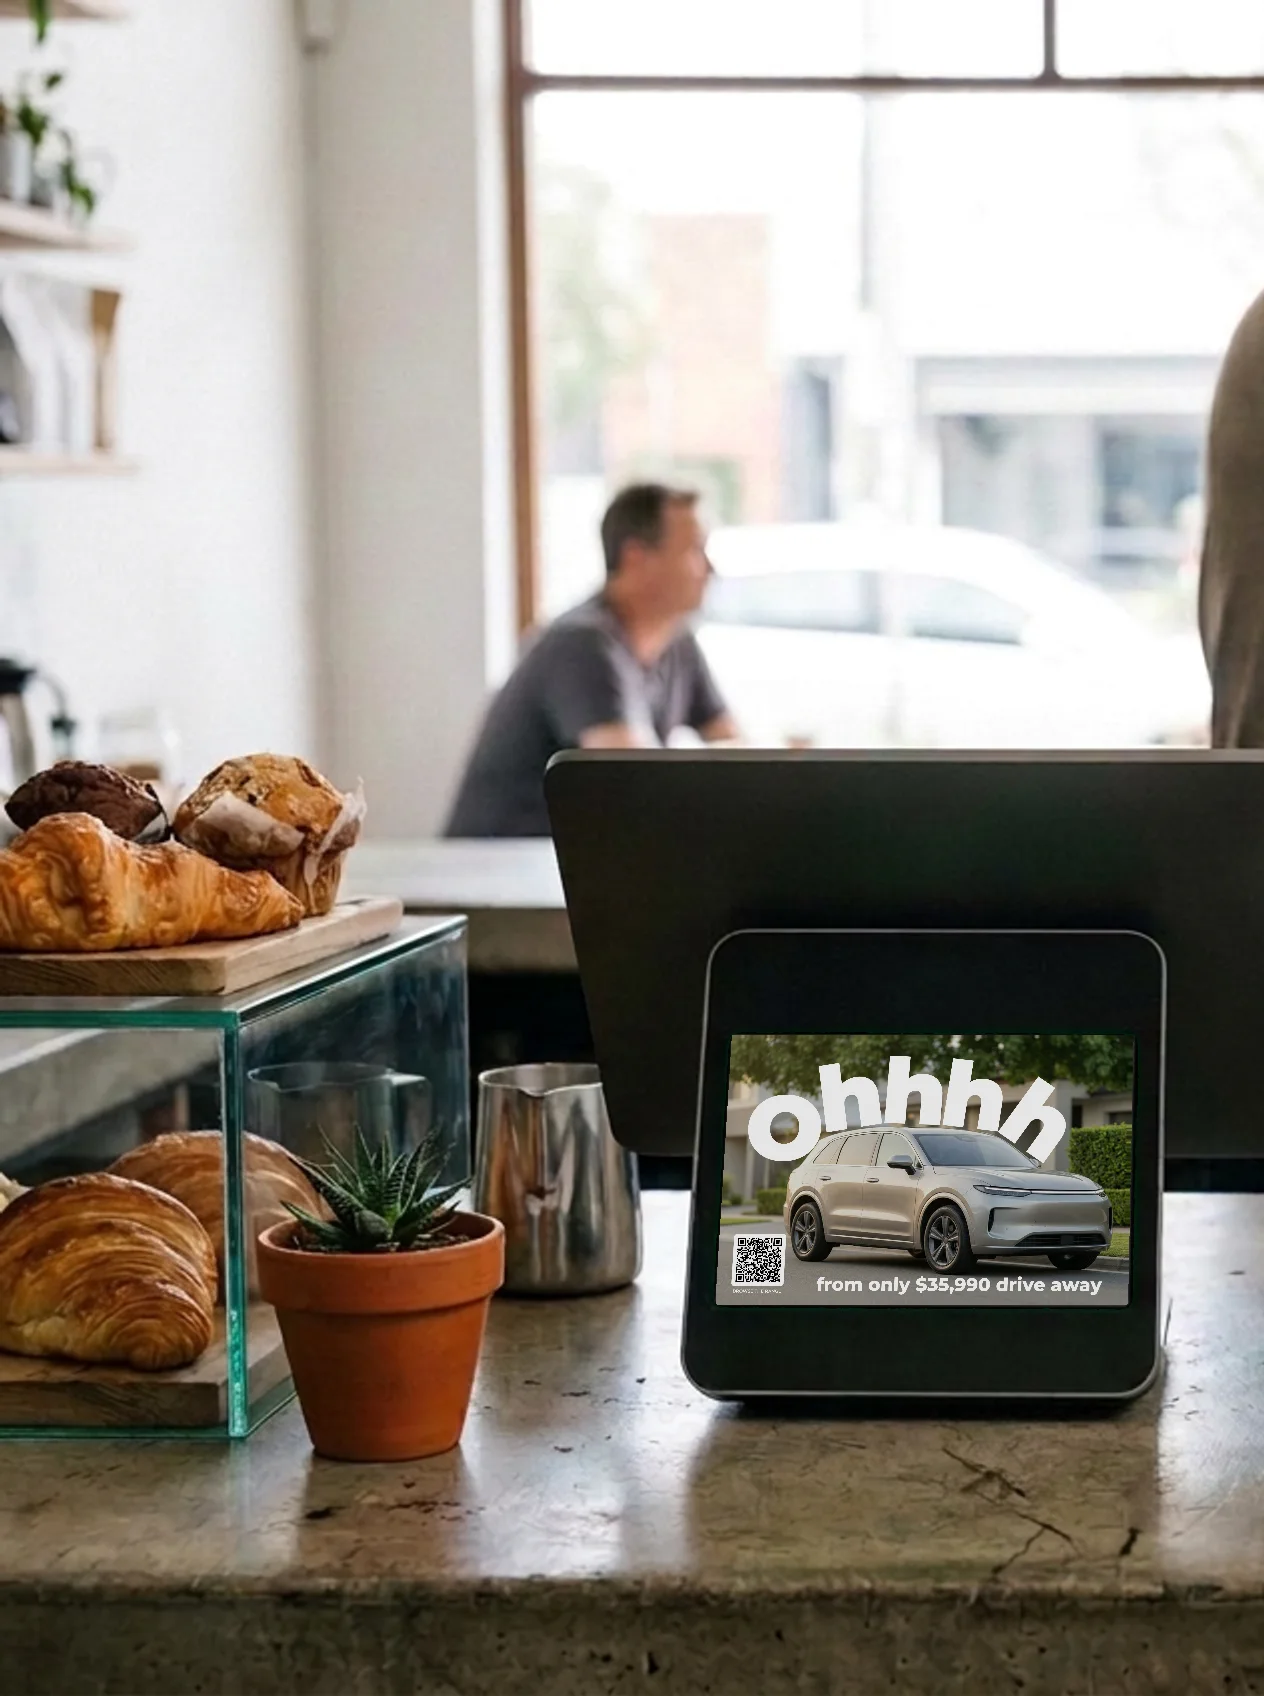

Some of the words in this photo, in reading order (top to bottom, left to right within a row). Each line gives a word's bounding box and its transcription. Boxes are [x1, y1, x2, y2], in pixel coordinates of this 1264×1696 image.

[747, 1055, 1067, 1163] ohhhh
[816, 1276, 863, 1292] from
[868, 1276, 911, 1296] only
[915, 1275, 991, 1294] $35,990
[995, 1276, 1046, 1292] drive
[1050, 1280, 1103, 1296] away
